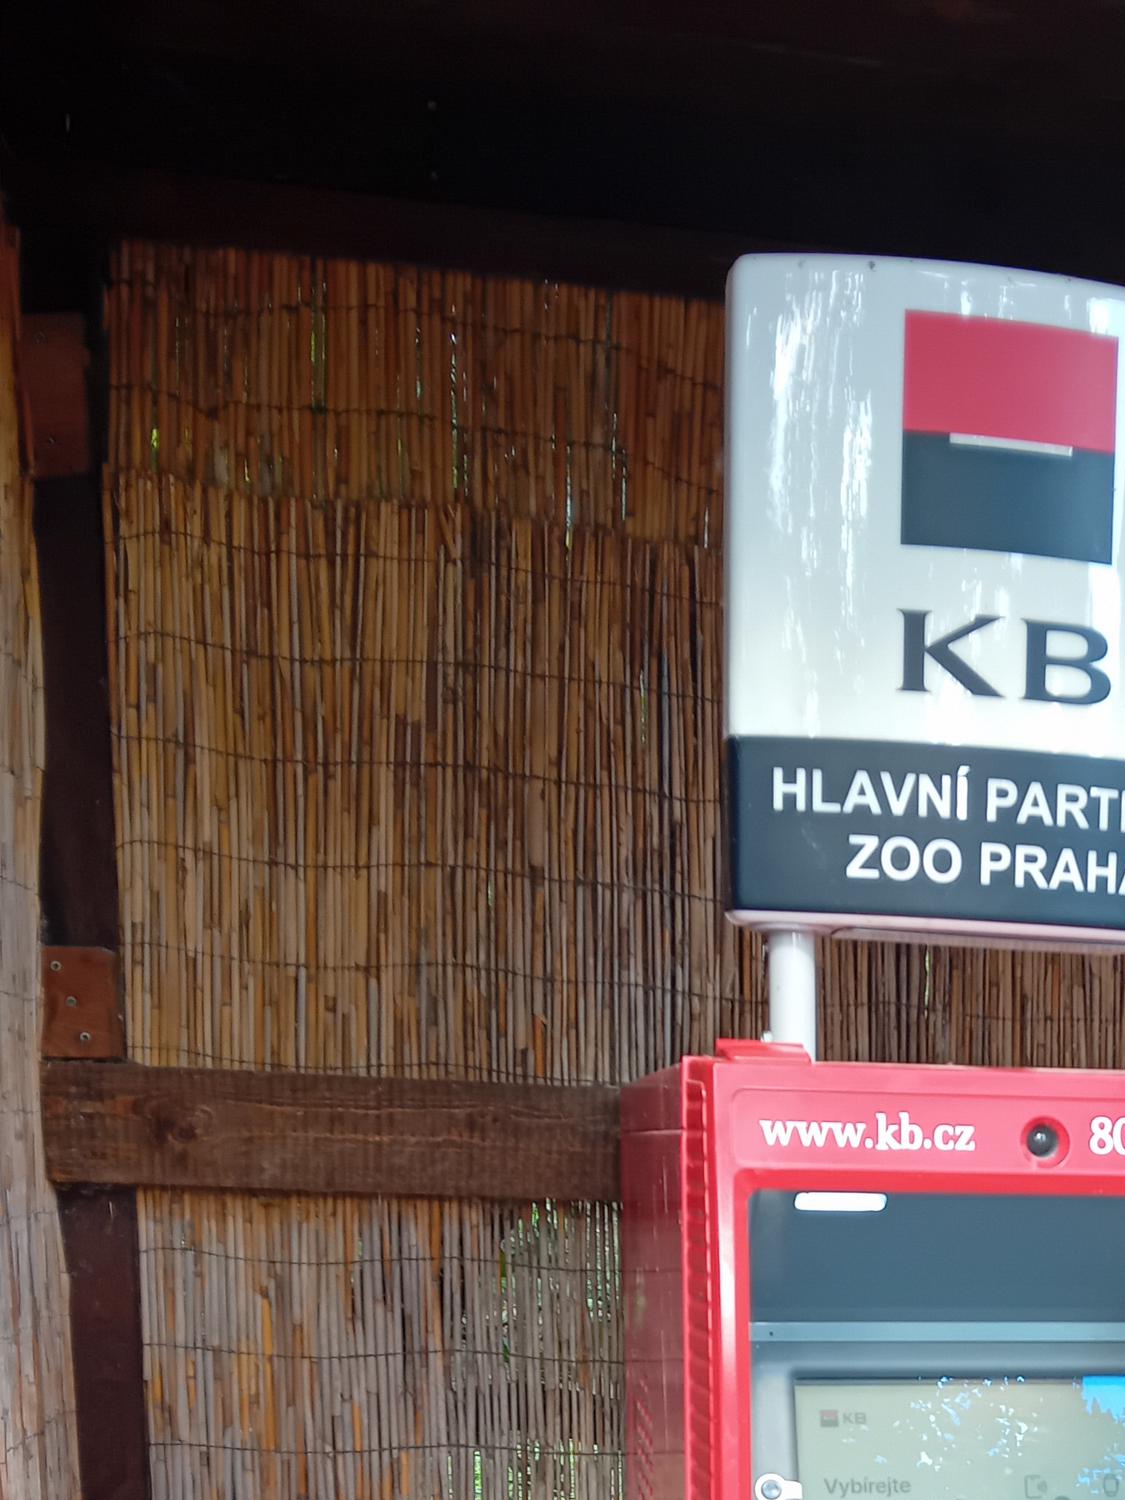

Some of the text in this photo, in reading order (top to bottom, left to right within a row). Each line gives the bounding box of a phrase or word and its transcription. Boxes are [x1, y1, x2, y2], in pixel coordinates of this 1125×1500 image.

[897, 608, 1111, 705] KB
[772, 765, 971, 821] HLAVNÍ
[845, 834, 963, 884] ZOO
[759, 1112, 975, 1152] www.kb.cz
[843, 1412, 867, 1425] KB
[824, 1477, 911, 1498] Vybírejte
